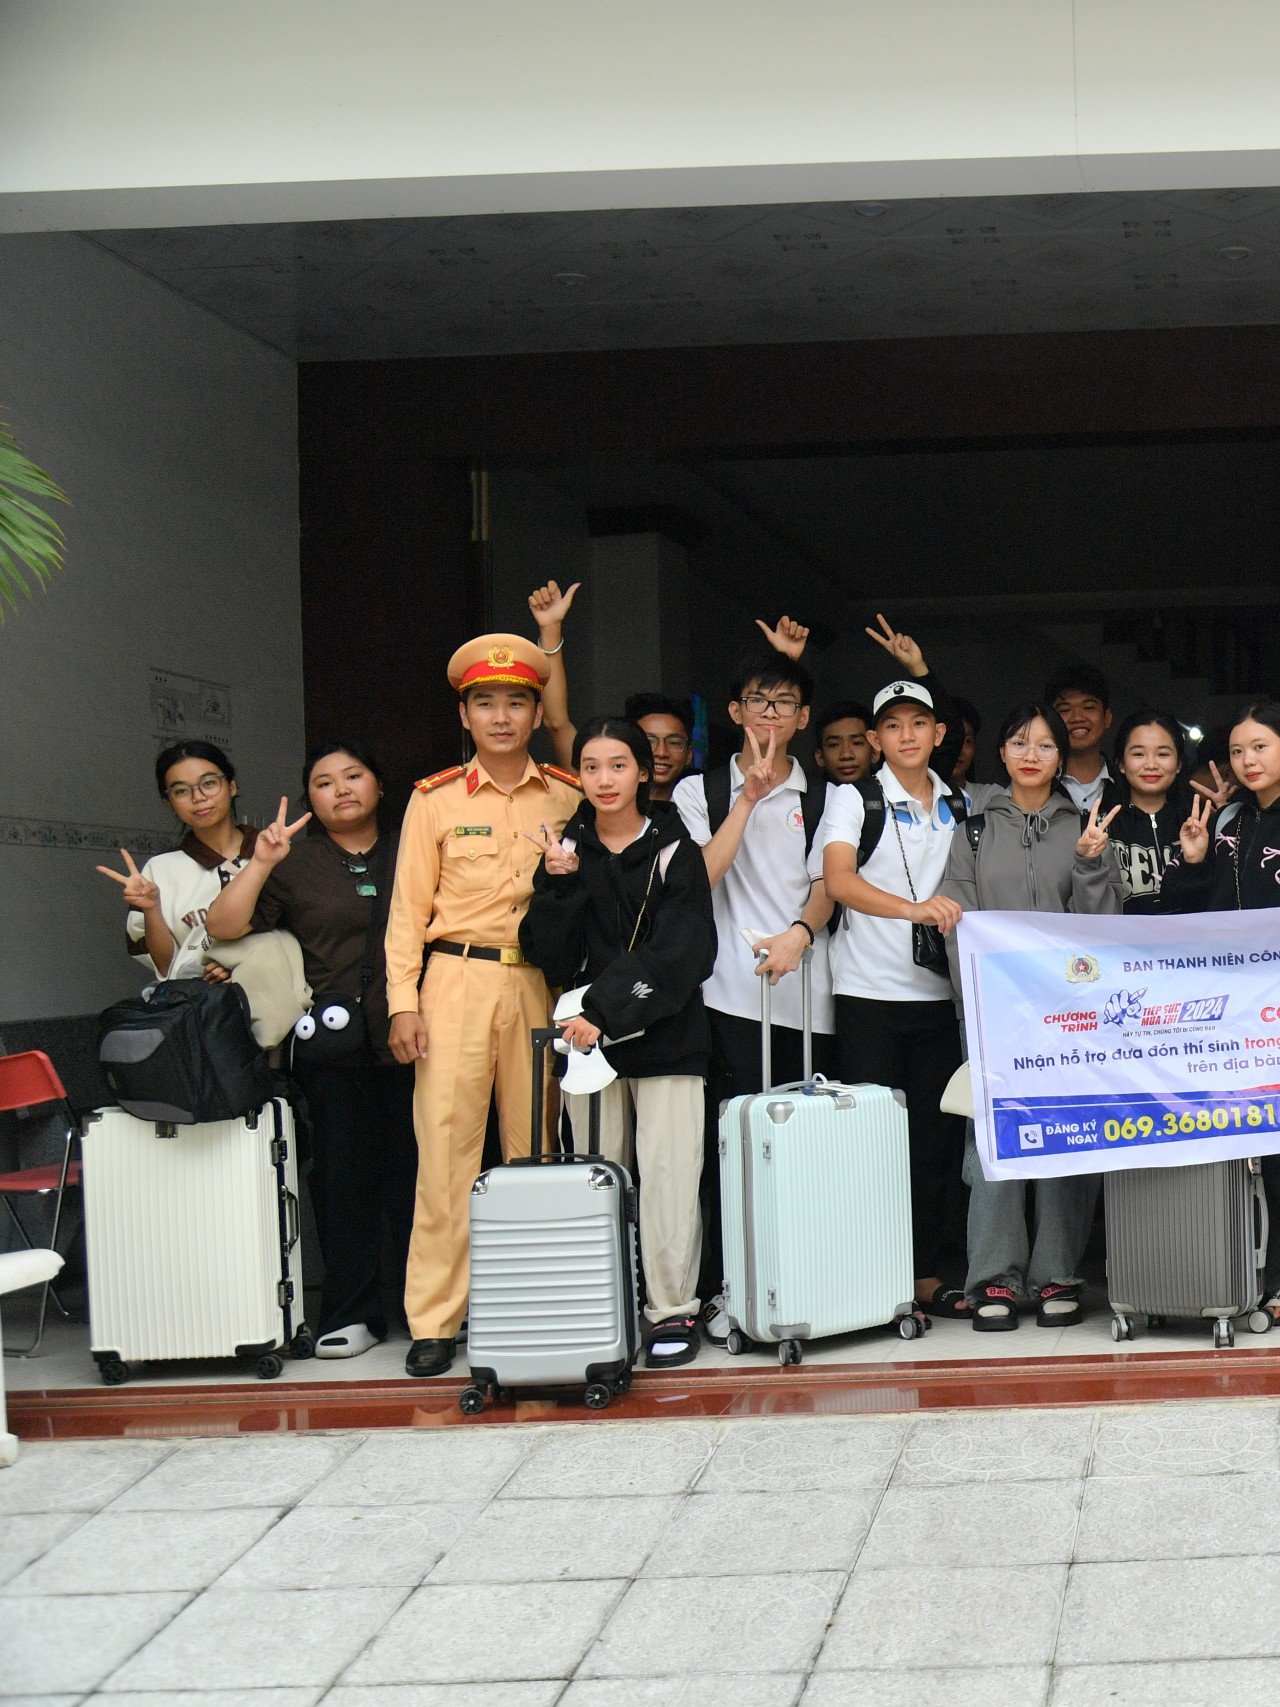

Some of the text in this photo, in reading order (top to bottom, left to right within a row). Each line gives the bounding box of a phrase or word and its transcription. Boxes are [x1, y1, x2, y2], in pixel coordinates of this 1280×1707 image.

[1123, 960, 1154, 973] BAN
[1158, 956, 1207, 970] THANH
[1212, 952, 1245, 967] NIÊN
[1043, 1010, 1097, 1025] CHƯƠNG
[1182, 997, 1224, 1021] 2024
[1061, 1021, 1098, 1033] TRÌNH
[1013, 1054, 1056, 1071] Nhận
[1061, 1048, 1080, 1065] hỗ
[1085, 1049, 1107, 1065] trợ
[1111, 1047, 1143, 1060] đưa
[1147, 1043, 1179, 1058] đón
[1183, 1038, 1204, 1055] thí
[1208, 1038, 1240, 1053] sinh
[1187, 1060, 1218, 1073] trên
[1223, 1057, 1249, 1073] địa
[1045, 1103, 1276, 1142] ĐĂNG KÝ 069.3680181
[1066, 1133, 1099, 1146] NGAY
